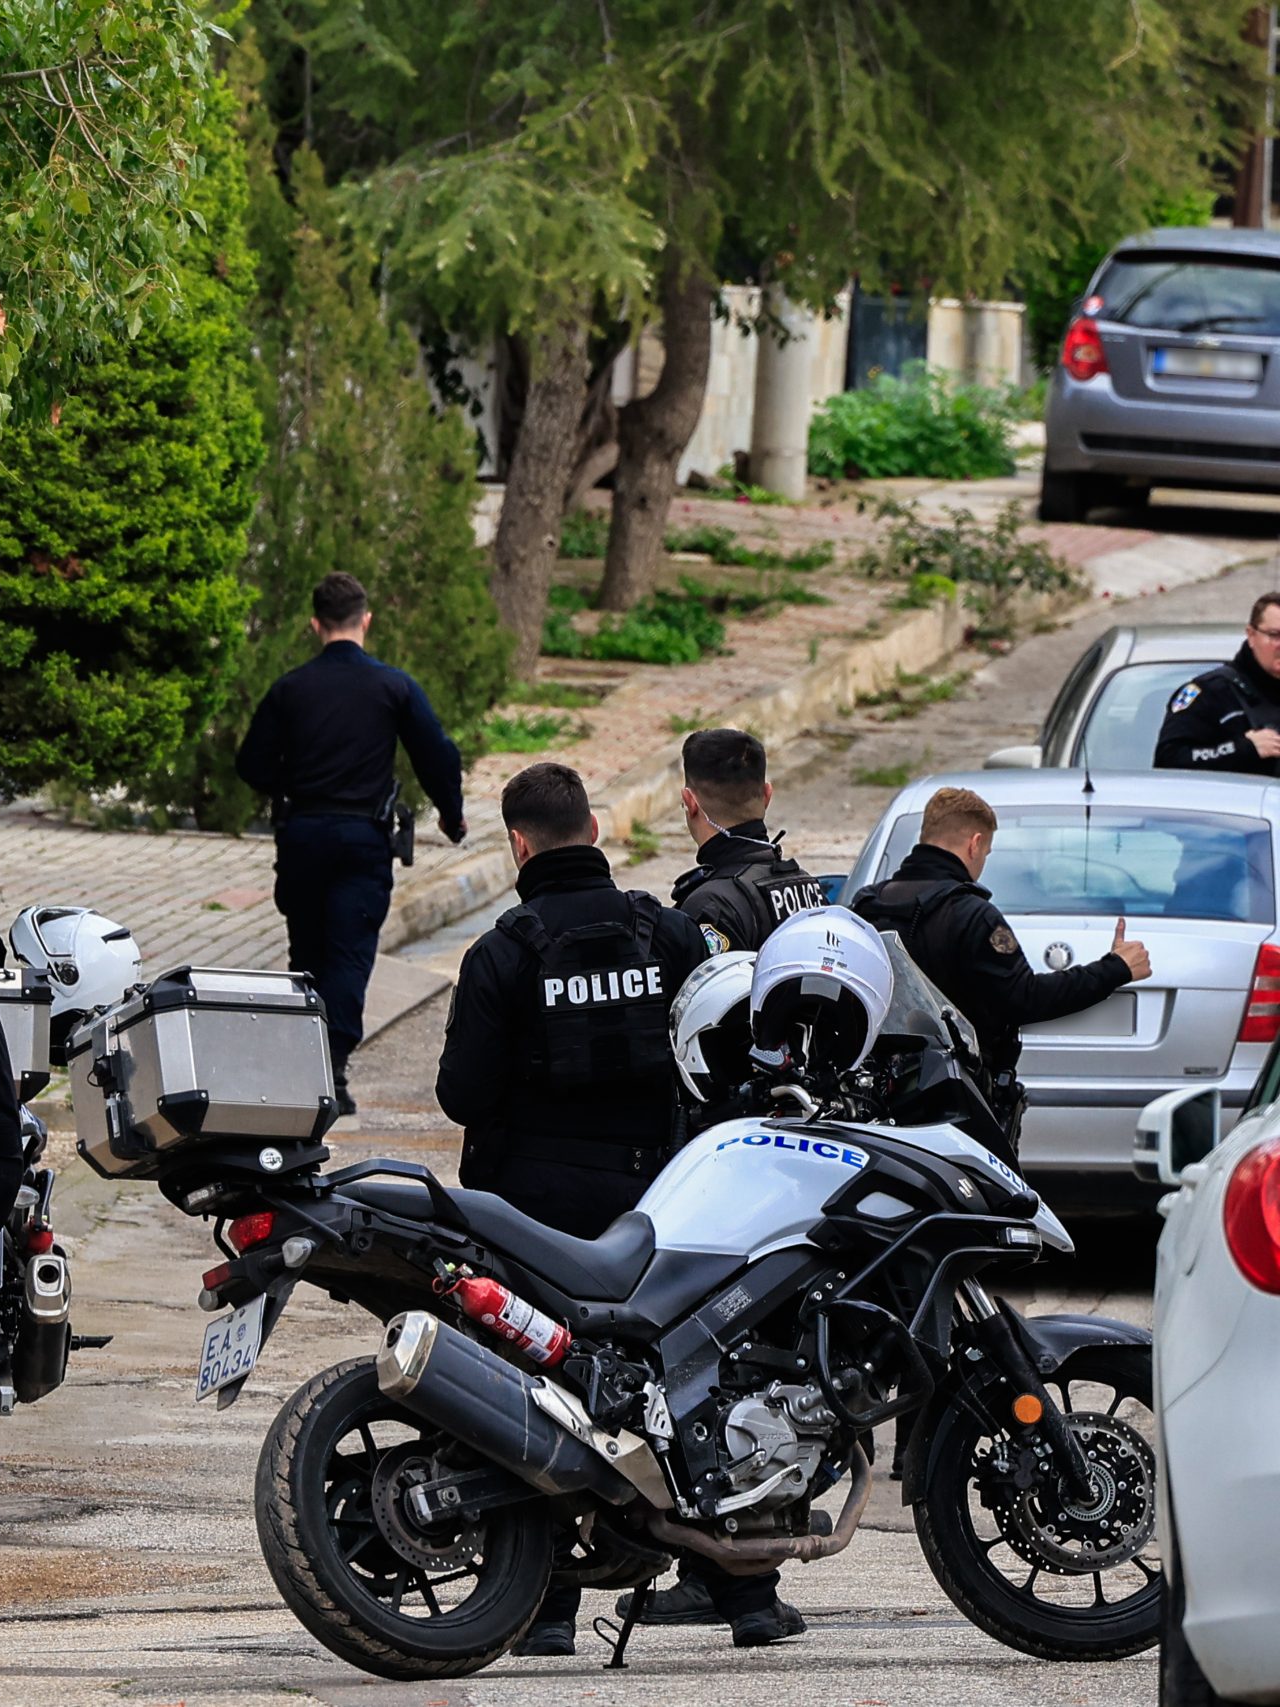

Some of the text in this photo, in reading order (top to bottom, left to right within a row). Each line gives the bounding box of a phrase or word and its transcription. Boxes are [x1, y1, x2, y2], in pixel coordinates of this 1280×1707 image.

[770, 883, 823, 920] POLICE
[544, 966, 663, 1007] POLICE
[716, 1135, 865, 1169] POLICE
[200, 1344, 251, 1391] 80434
